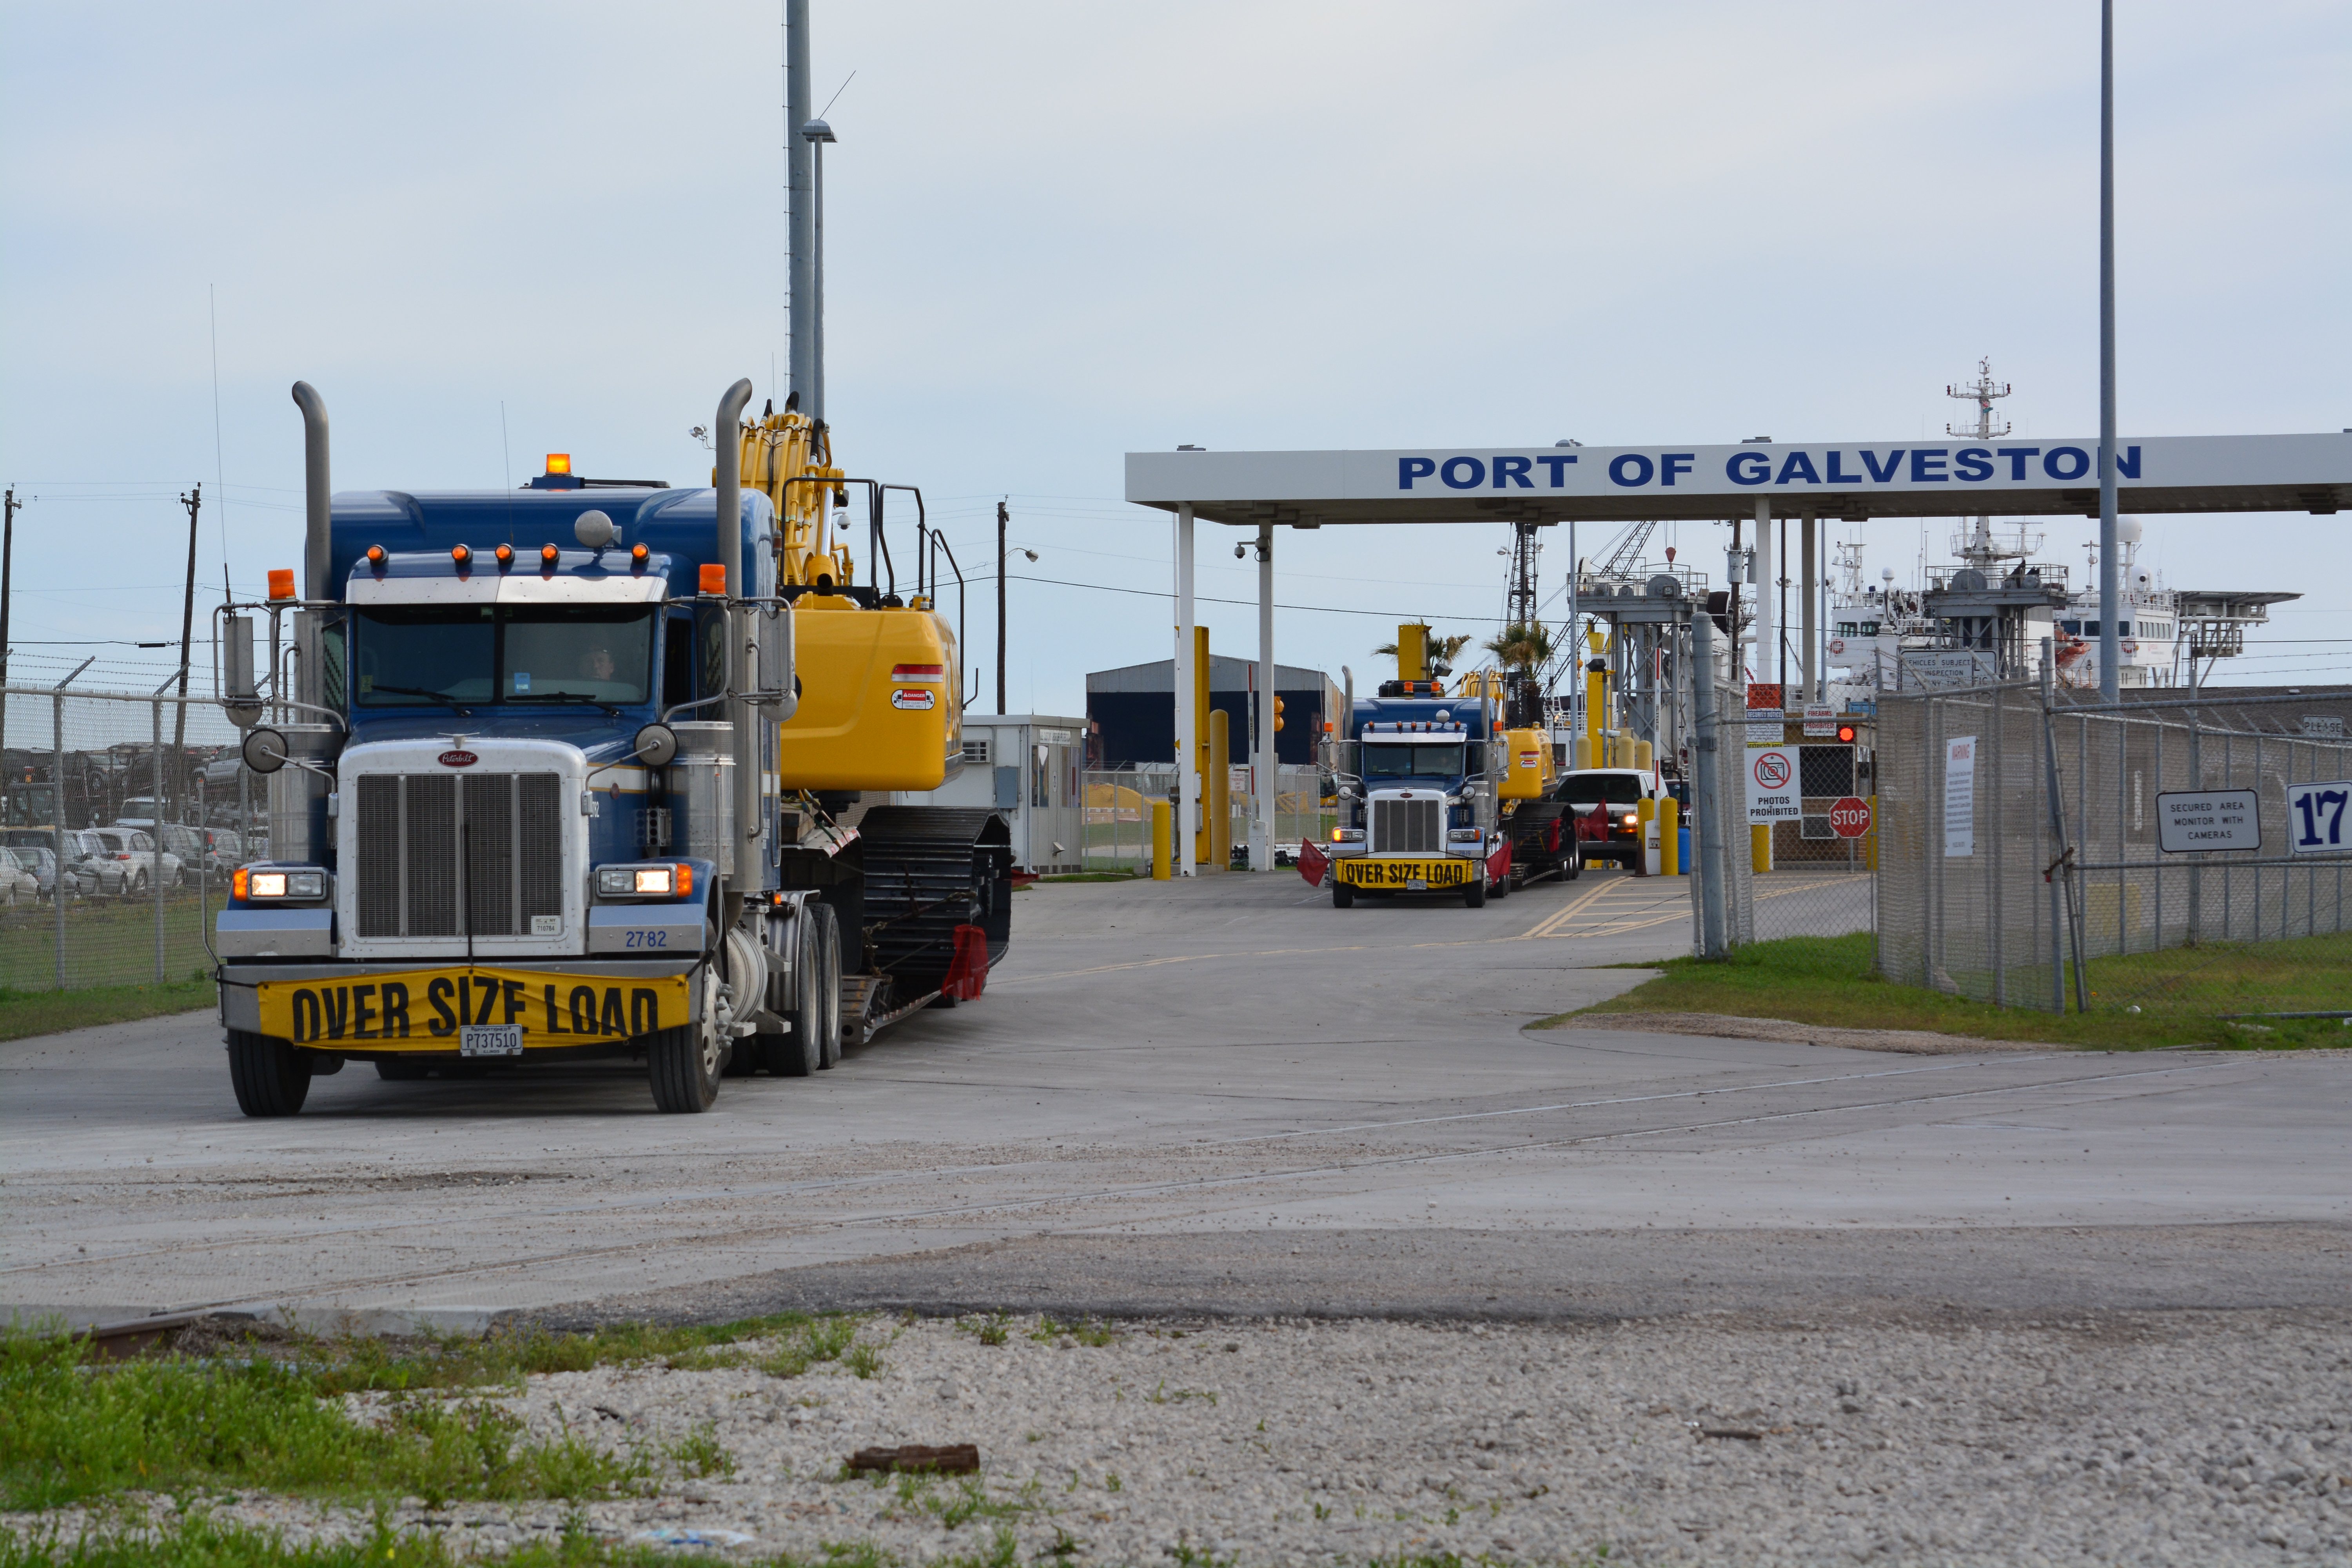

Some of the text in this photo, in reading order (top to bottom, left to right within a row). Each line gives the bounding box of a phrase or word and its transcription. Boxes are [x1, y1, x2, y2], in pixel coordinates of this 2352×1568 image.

[1398, 445, 2141, 490] PORT OF GALVESTON
[2305, 722, 2341, 732] PLEASE
[442, 753, 475, 763] Peterbilt
[1758, 796, 1790, 805] PHOTOS
[1750, 807, 1798, 817] PROHIBITED
[2171, 803, 2212, 812] SECURED
[1832, 809, 1868, 825] STOP
[2174, 817, 2214, 826] MONITOR
[2295, 790, 2348, 846] 17
[2188, 831, 2232, 840] CAMERAS
[1345, 863, 1463, 884] OVER SIZE LOAD
[626, 931, 666, 947] 2782
[292, 975, 658, 1042] OVER SIZE LOAD
[466, 1033, 517, 1048] P737510
